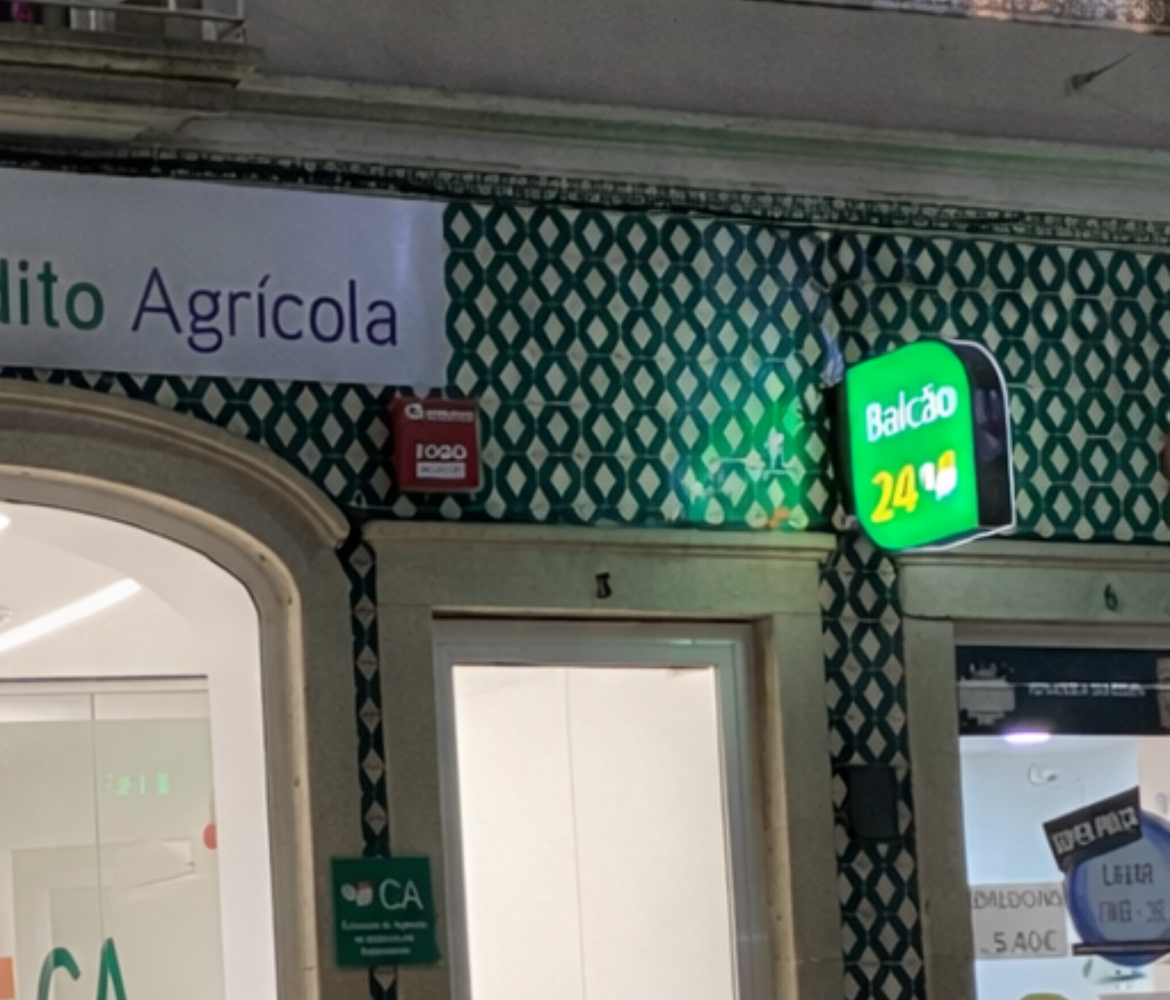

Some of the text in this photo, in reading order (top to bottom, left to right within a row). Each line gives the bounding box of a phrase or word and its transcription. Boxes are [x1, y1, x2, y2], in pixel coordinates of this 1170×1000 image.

[130, 264, 399, 354] Agrícola
[865, 382, 958, 443] Balcão
[870, 463, 919, 523] 24
[379, 878, 424, 911] CA
